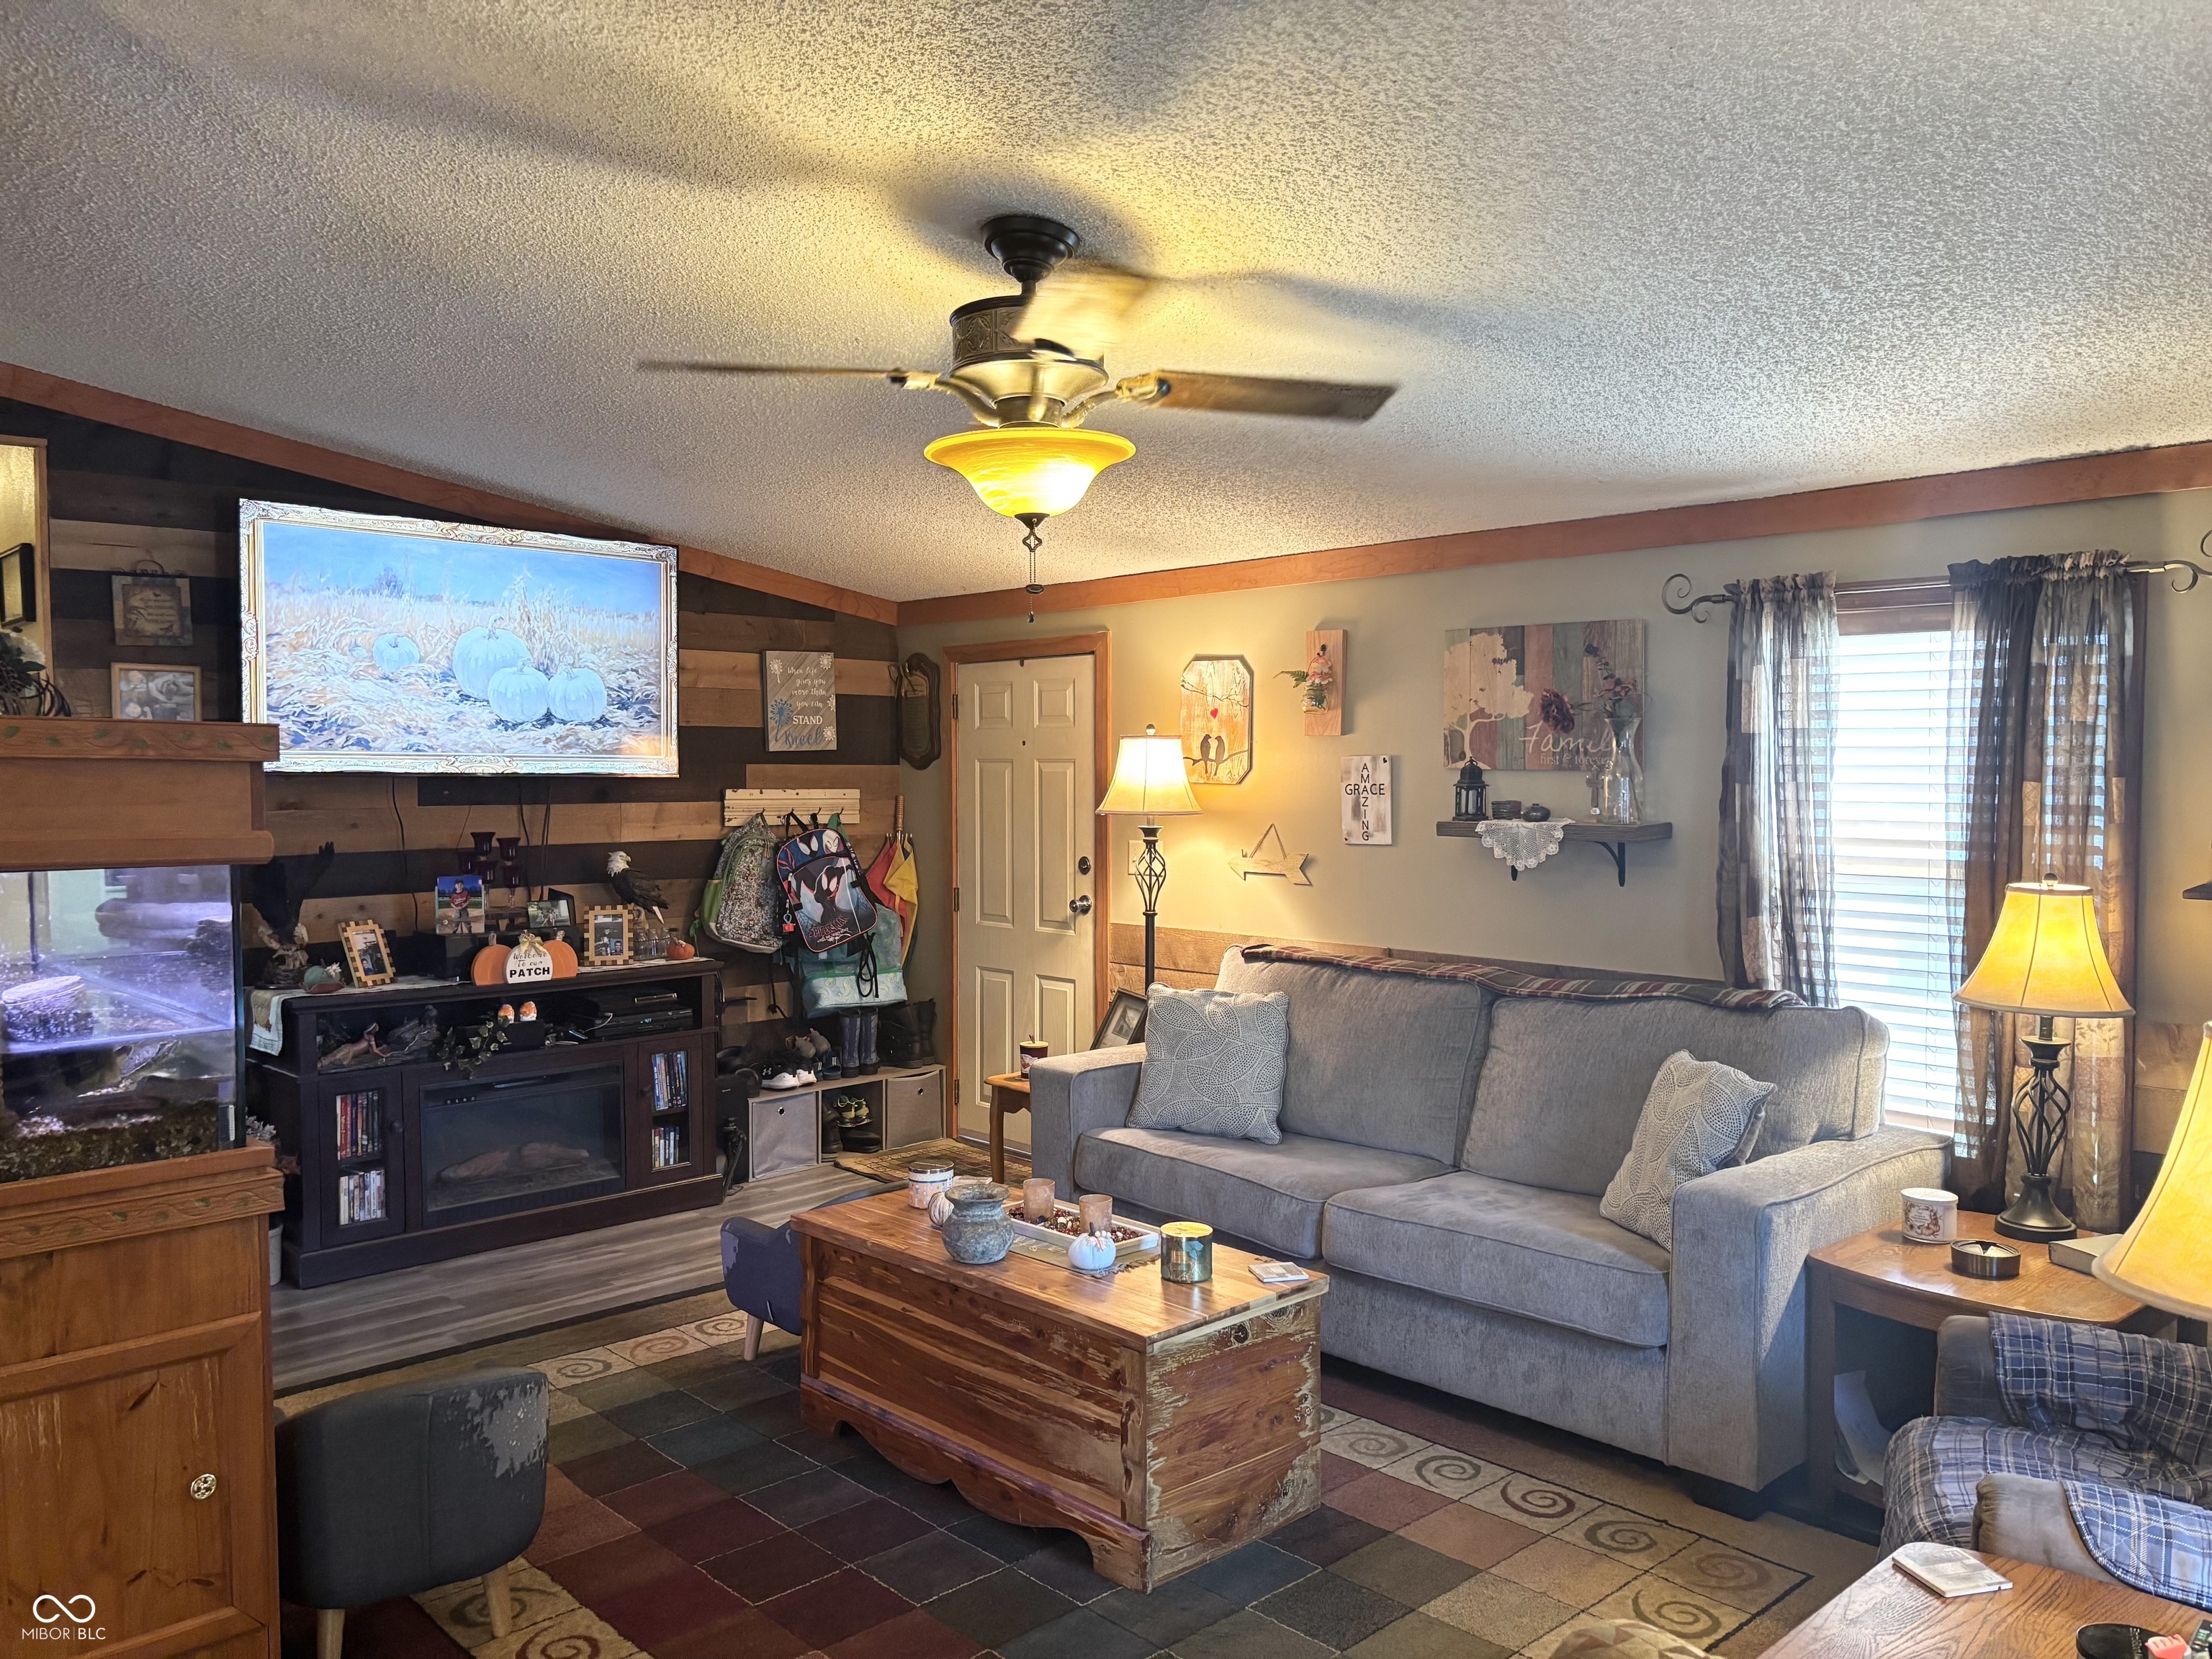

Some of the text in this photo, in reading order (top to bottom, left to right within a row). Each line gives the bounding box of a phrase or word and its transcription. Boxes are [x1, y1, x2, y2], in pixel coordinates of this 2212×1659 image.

[787, 667, 818, 675] When life
[796, 678, 826, 688] gives you
[796, 701, 809, 710] you
[792, 715, 823, 725] STAND
[784, 726, 824, 748] Kneel
[1519, 720, 1614, 754] Famil
[1540, 753, 1559, 764] first
[1344, 783, 1385, 796] GRACE
[1360, 763, 1370, 841] AMAZING
[509, 966, 550, 978] PATCH
